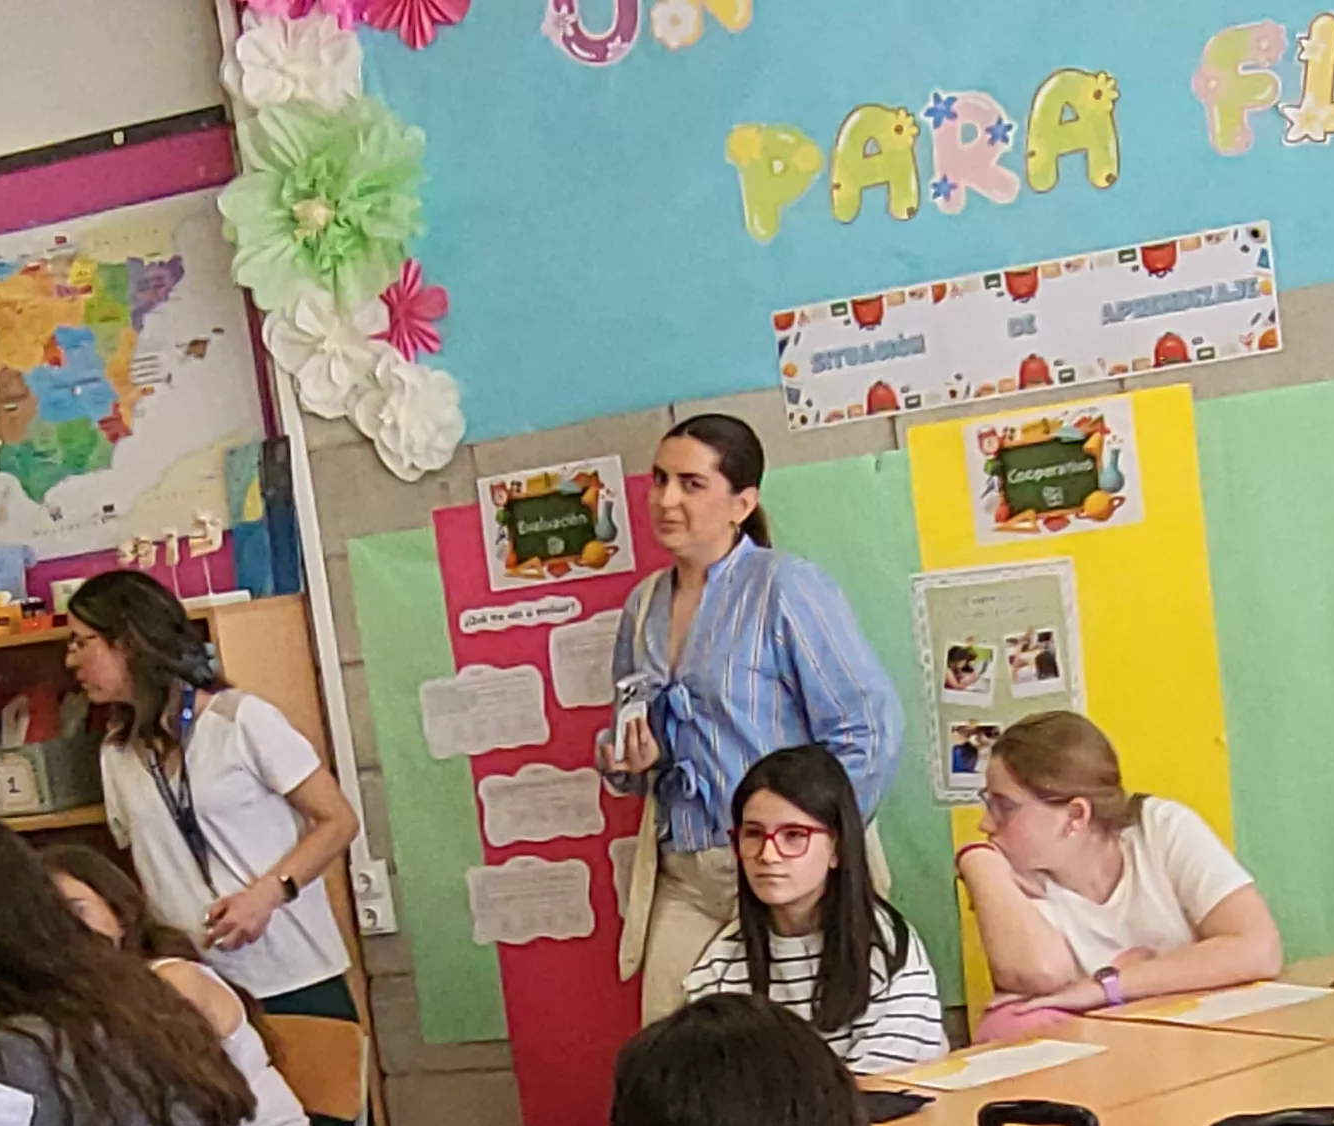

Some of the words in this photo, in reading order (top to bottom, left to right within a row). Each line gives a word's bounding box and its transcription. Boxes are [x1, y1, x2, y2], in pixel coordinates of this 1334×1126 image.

[725, 68, 1121, 243] PARA
[1007, 314, 1037, 338] DE
[1099, 276, 1261, 326] APRENDIZAJE
[517, 512, 588, 536] Evaluación
